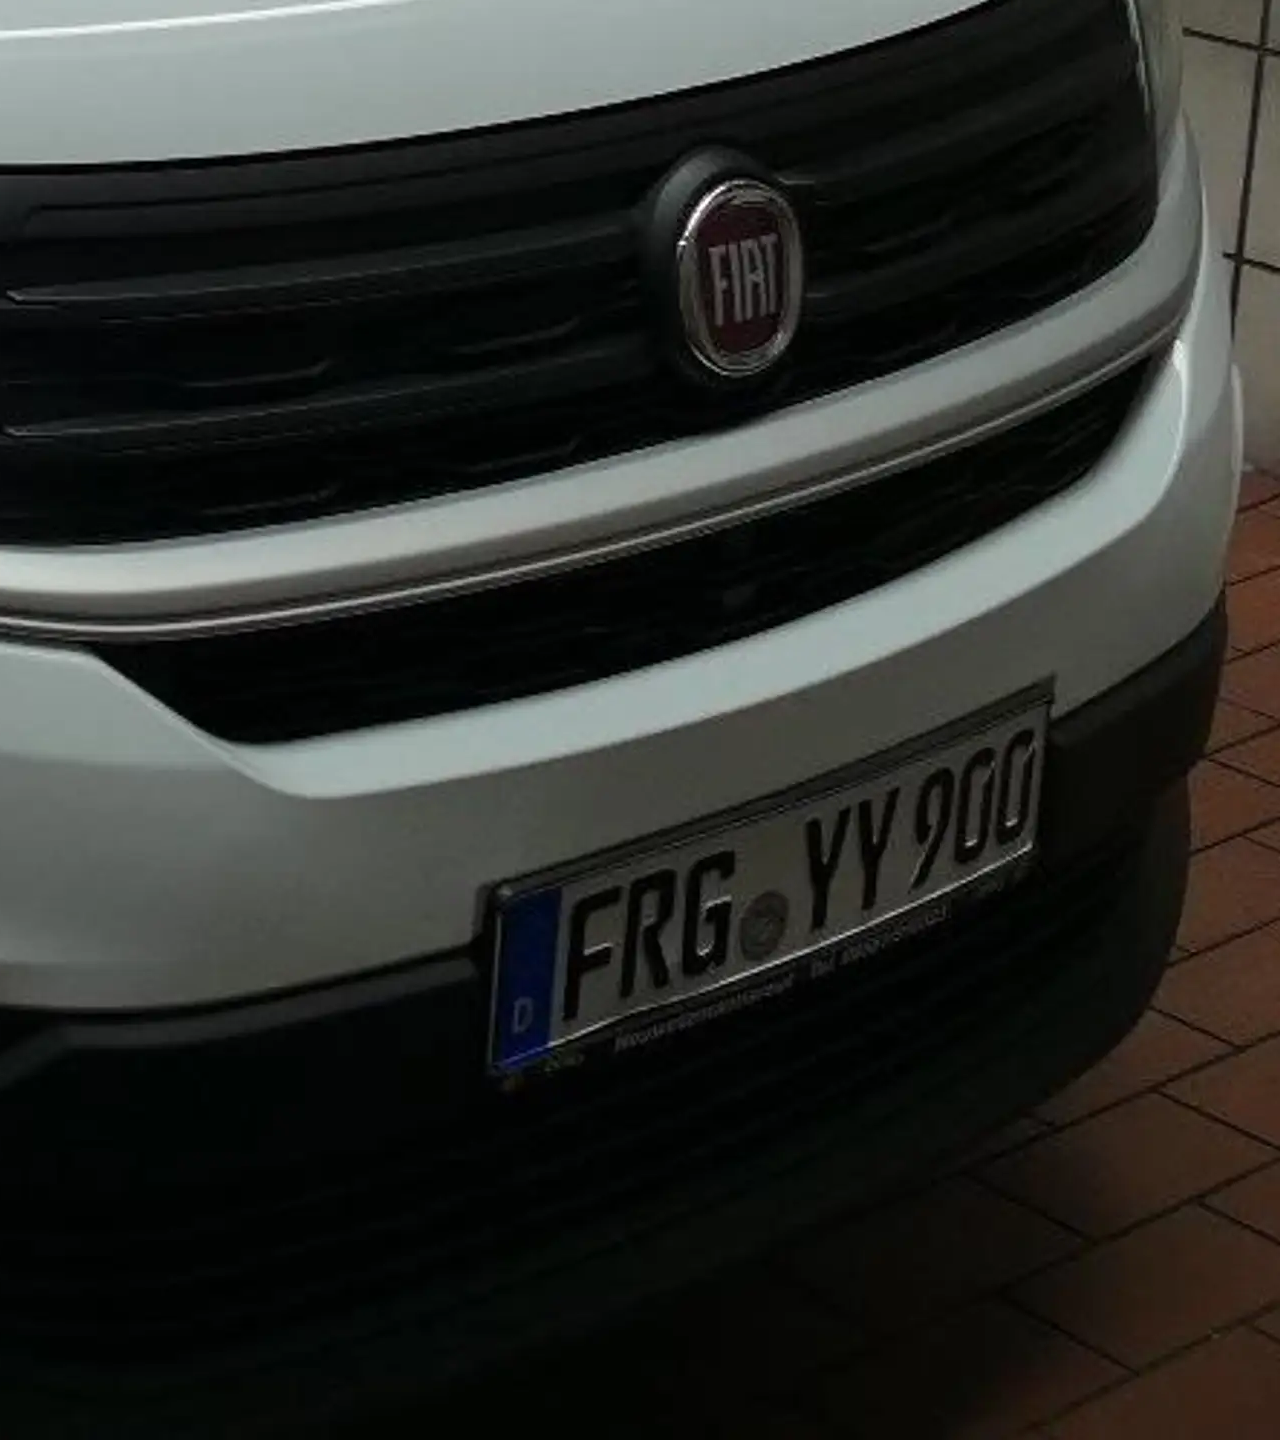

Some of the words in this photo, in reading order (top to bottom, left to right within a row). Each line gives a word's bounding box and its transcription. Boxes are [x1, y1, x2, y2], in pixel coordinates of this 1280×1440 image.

[707, 234, 779, 326] FIAT
[562, 851, 735, 1021] FRG
[806, 788, 900, 930] YY
[912, 728, 1036, 889] 900
[512, 997, 533, 1034] D
